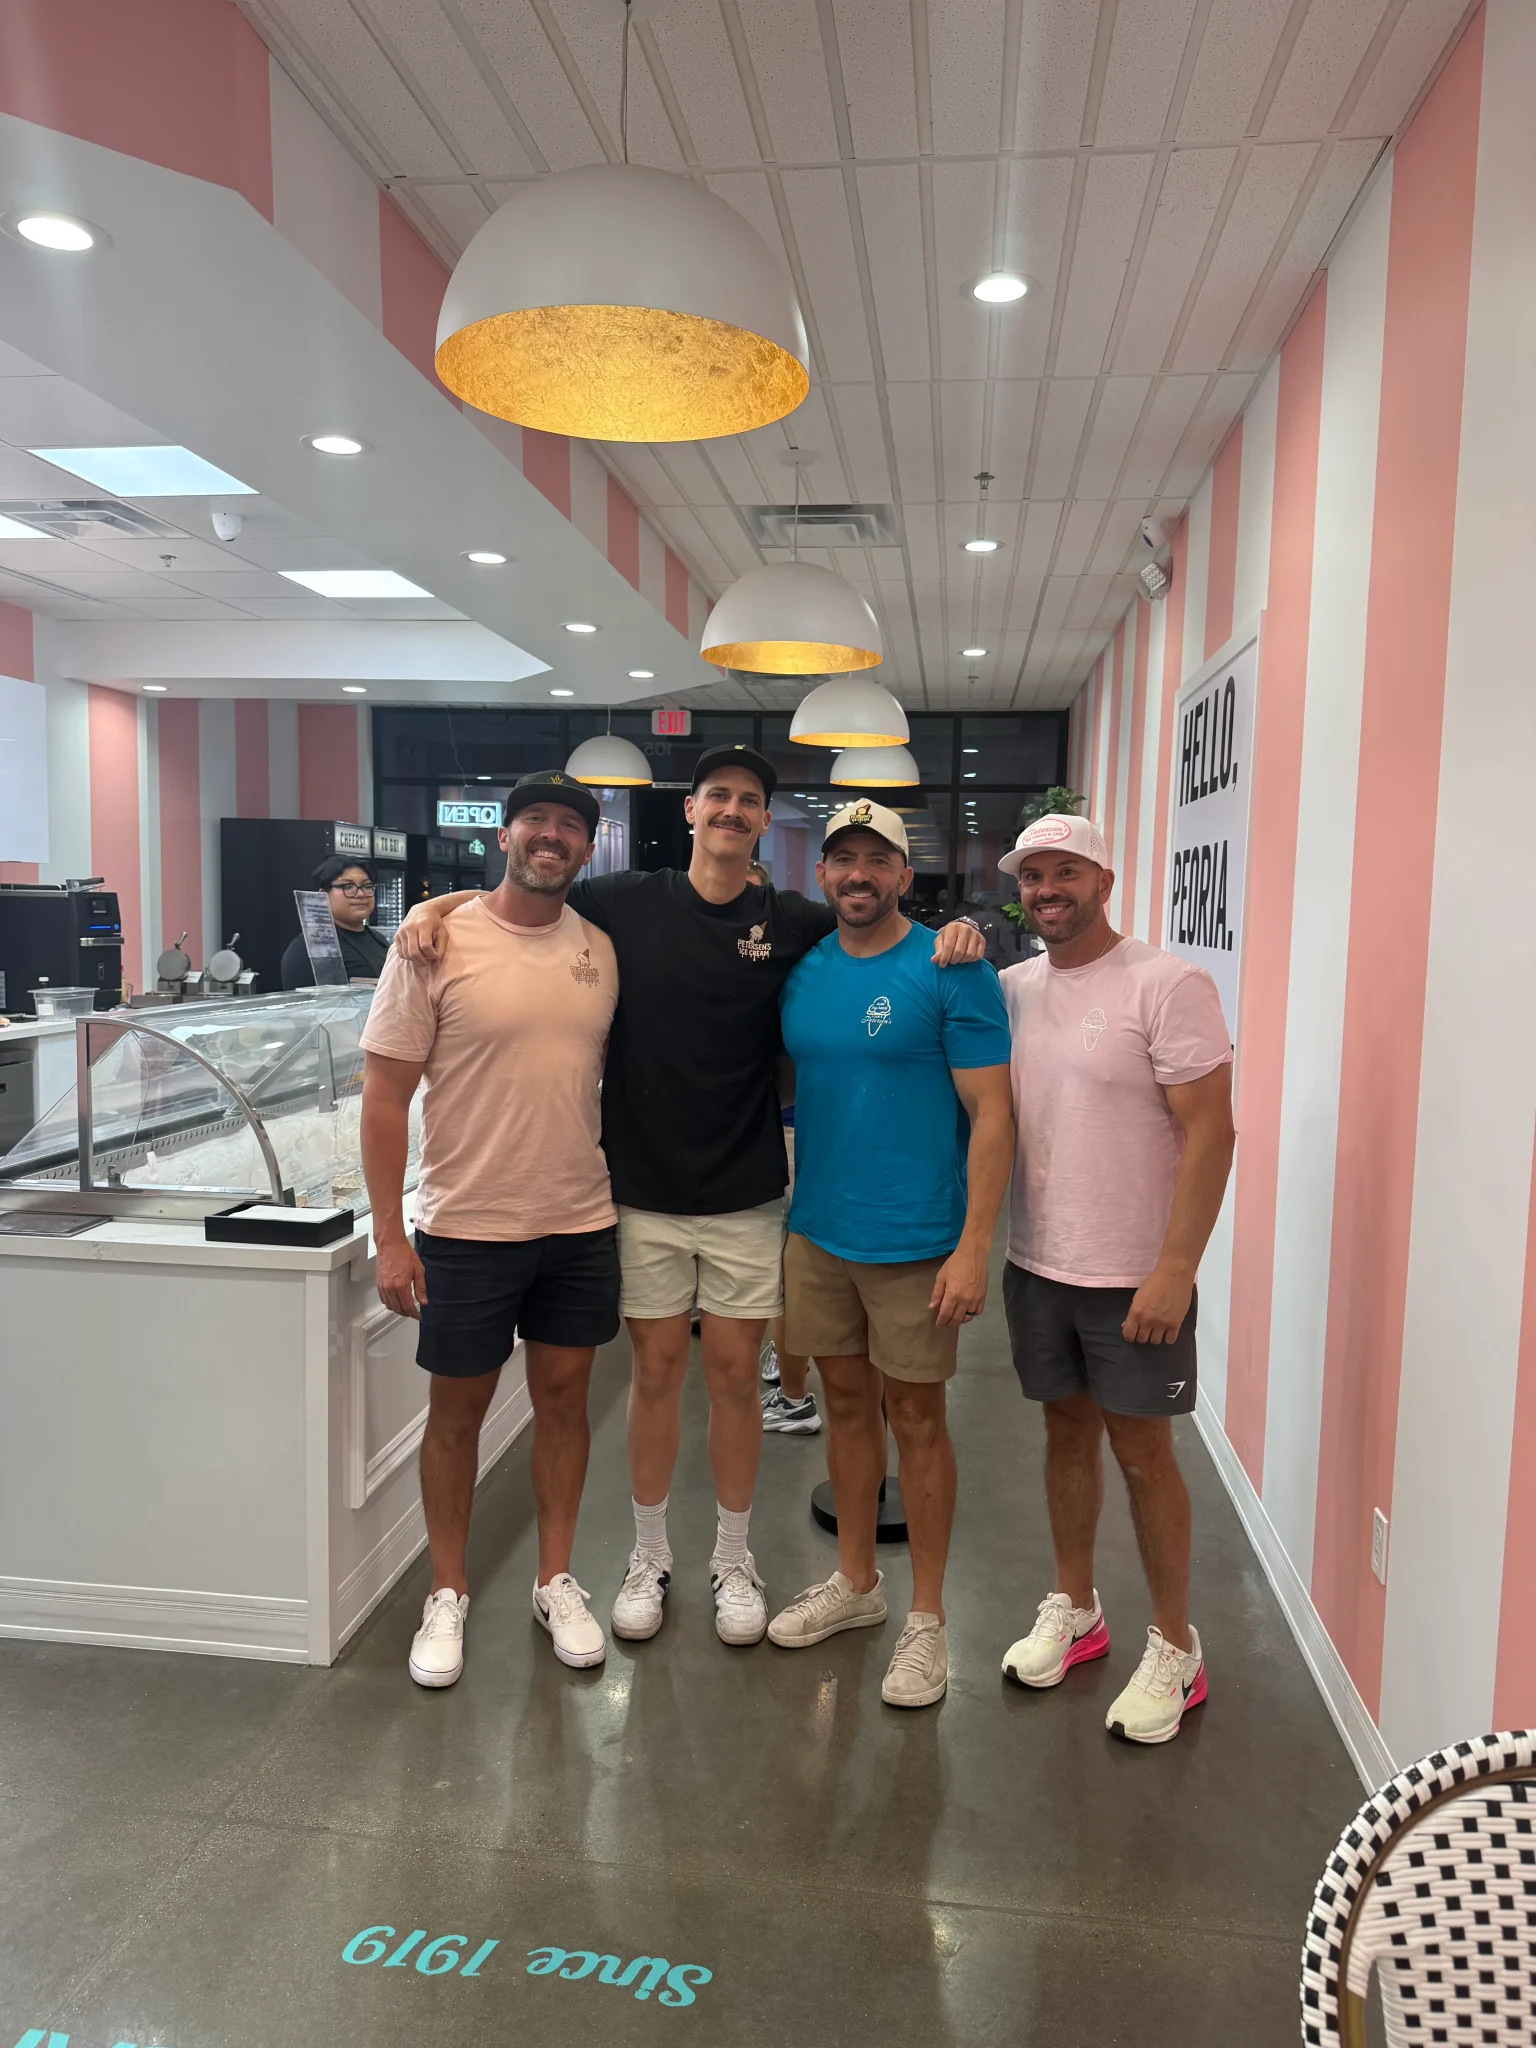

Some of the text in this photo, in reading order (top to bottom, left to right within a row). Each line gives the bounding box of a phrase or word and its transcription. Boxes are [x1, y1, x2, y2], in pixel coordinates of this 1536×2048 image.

[658, 711, 686, 734] EXIT
[1179, 675, 1238, 807] HELLO,
[340, 832, 366, 850] CHEERS!
[381, 837, 388, 851] TO
[1170, 840, 1233, 951] PEORIA.
[737, 938, 772, 951] PETERSEN'S
[749, 950, 770, 960] CREAM
[342, 1926, 712, 2007] Since 1919
